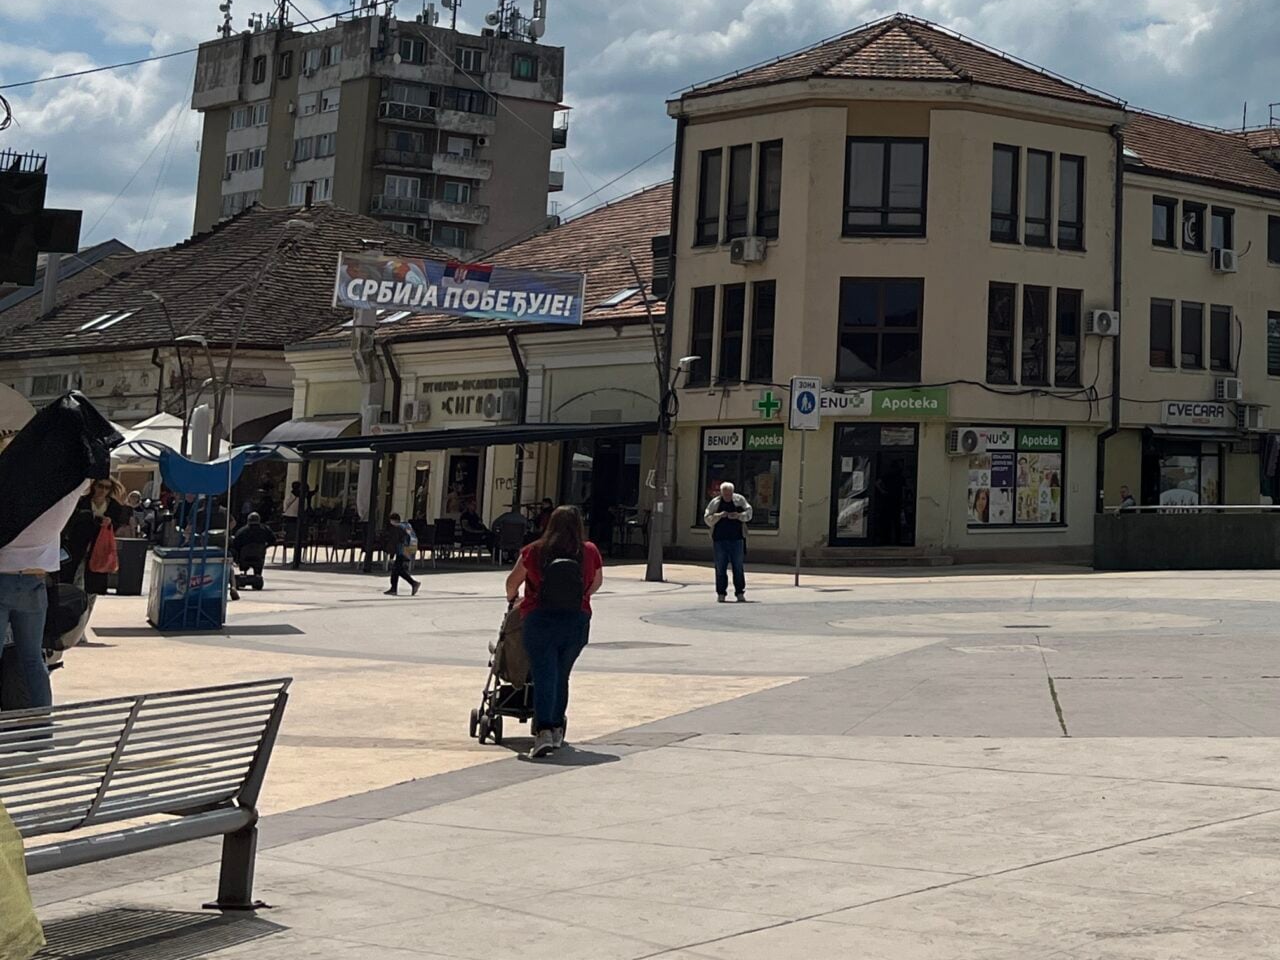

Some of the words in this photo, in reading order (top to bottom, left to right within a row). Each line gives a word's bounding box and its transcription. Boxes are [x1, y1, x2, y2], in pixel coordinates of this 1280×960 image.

[347, 278, 438, 307] СРБИЈА
[443, 288, 574, 317] ПОБЕЂУЈЕ!
[820, 397, 848, 408] ENU
[881, 397, 938, 411] Apoteka
[707, 435, 730, 446] BENU
[749, 433, 783, 447] Apoteka
[1022, 434, 1059, 447] Apoteka
